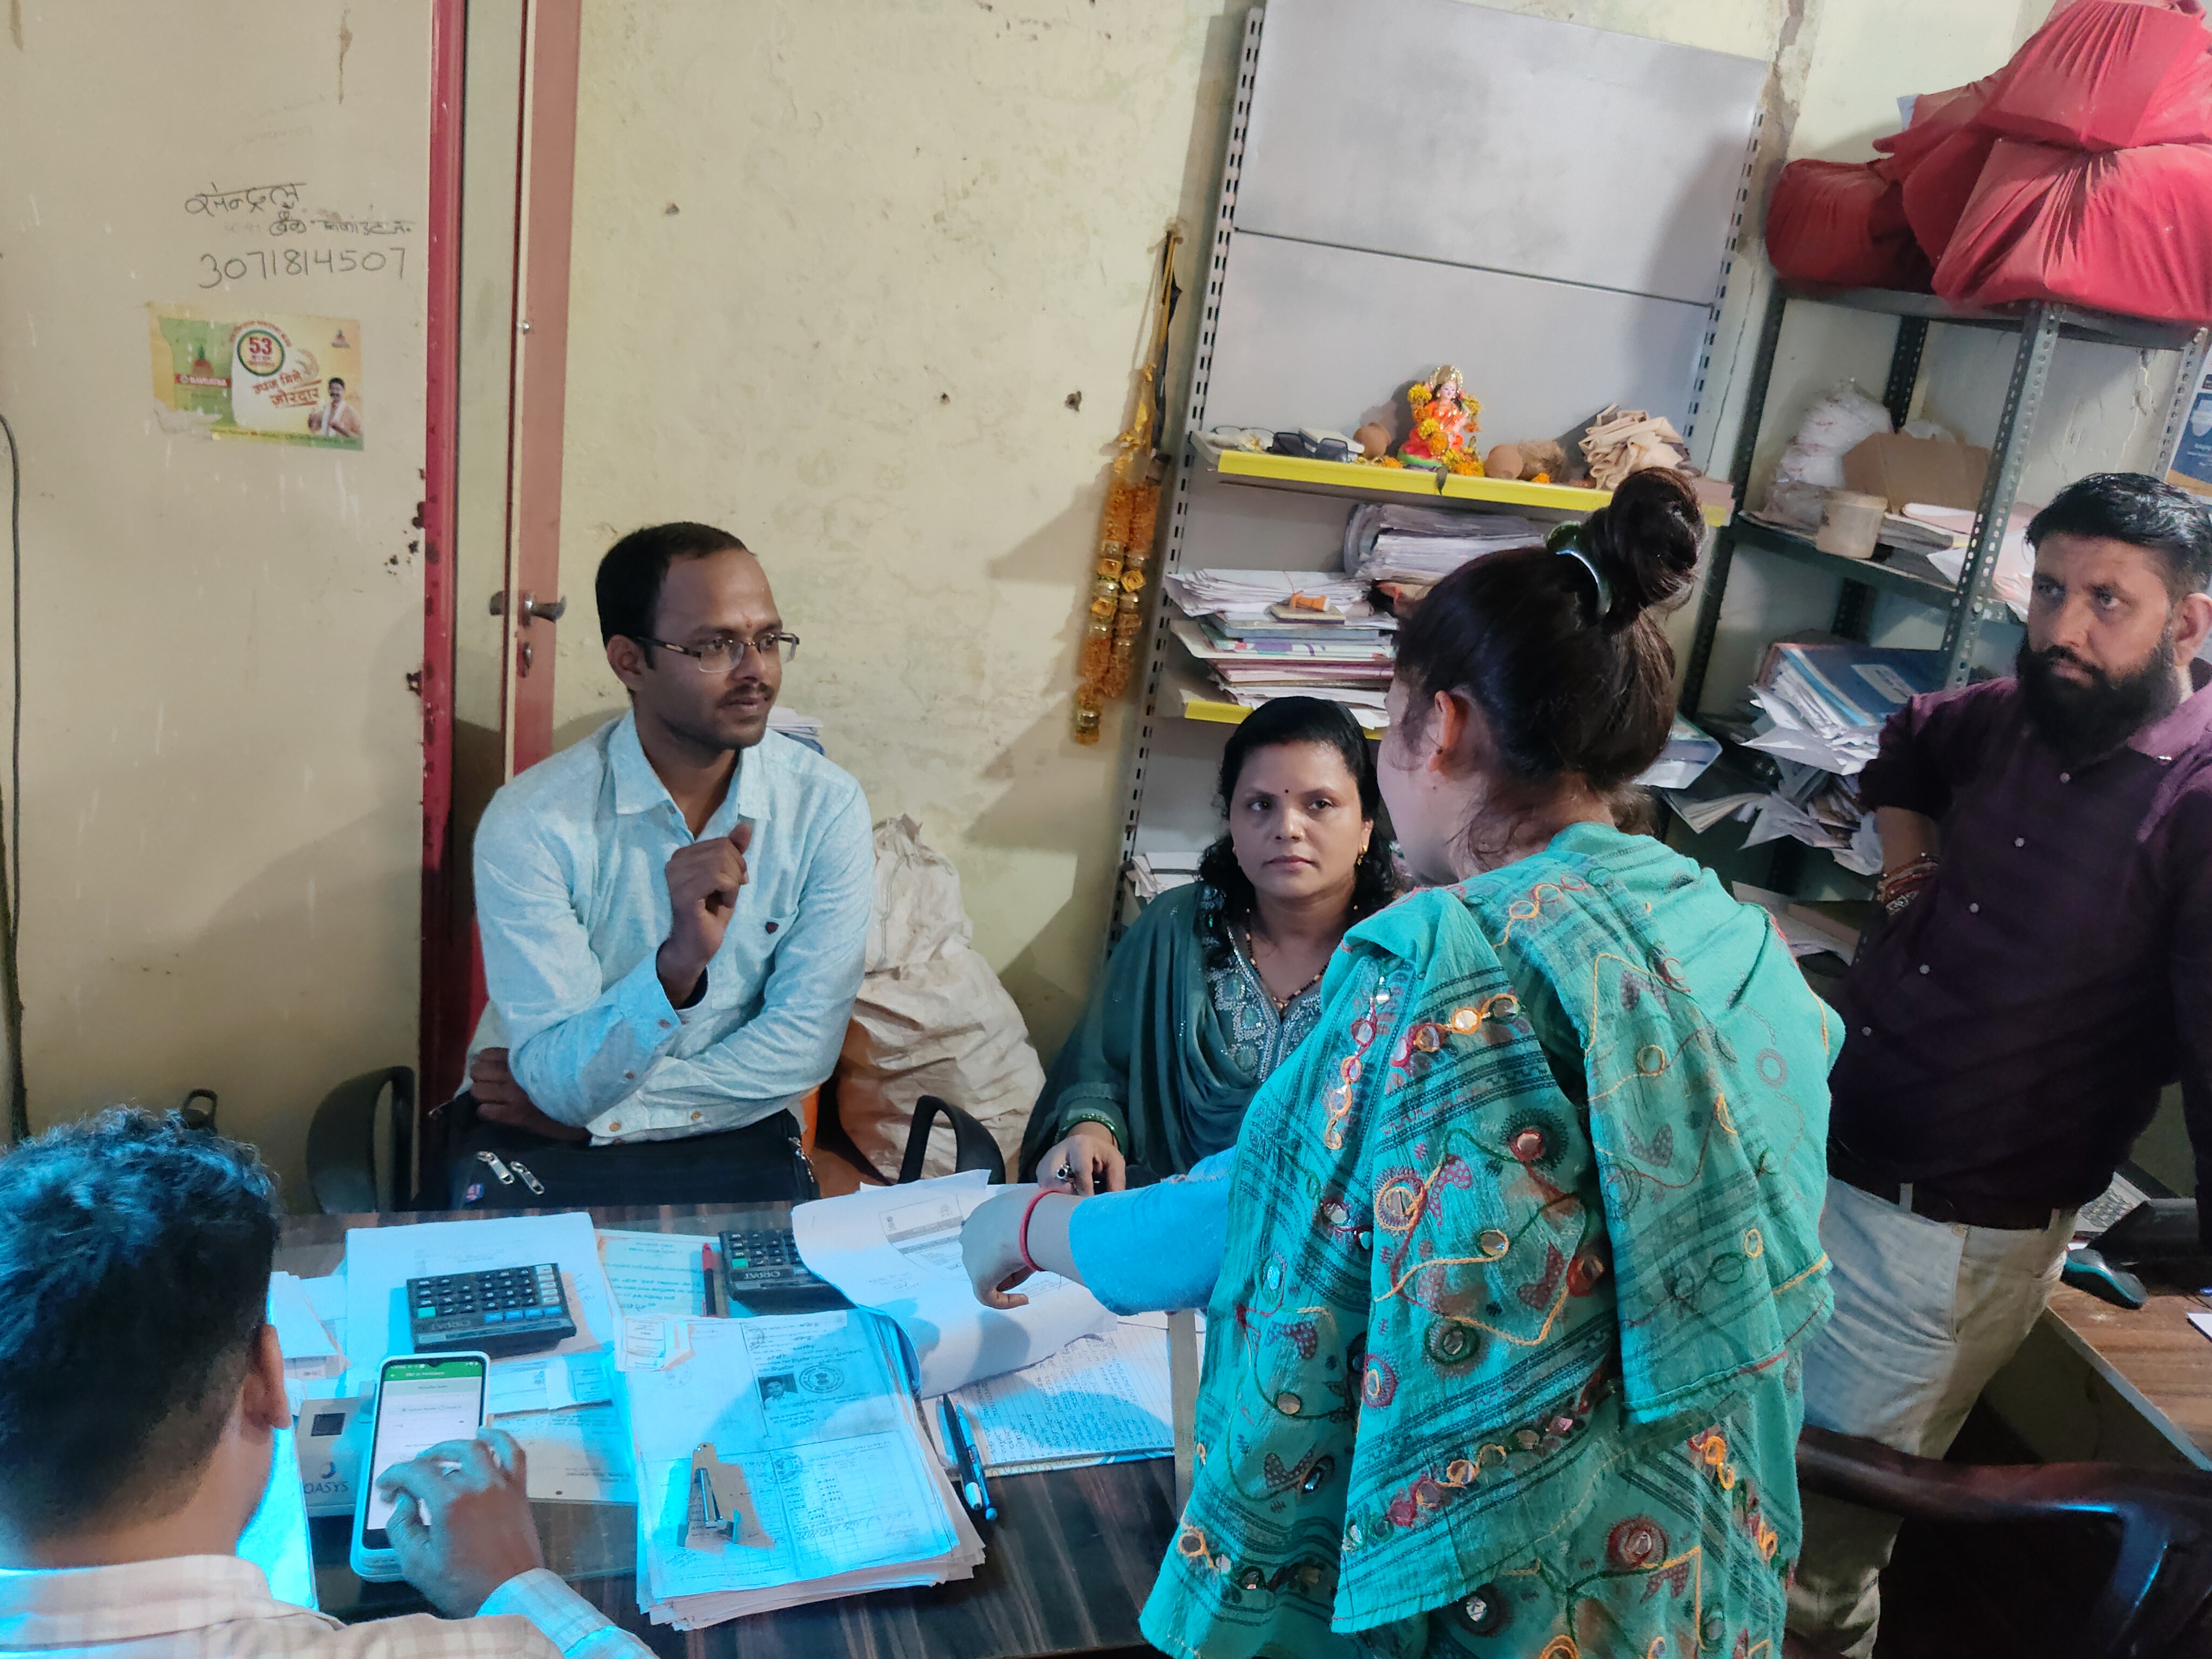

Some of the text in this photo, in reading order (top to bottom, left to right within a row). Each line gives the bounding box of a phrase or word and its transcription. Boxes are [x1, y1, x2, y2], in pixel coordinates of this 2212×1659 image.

[199, 248, 405, 288] 3071814507
[249, 336, 272, 355] 53
[744, 1270, 781, 1279] ORPAT
[304, 1481, 349, 1494] OASYS
